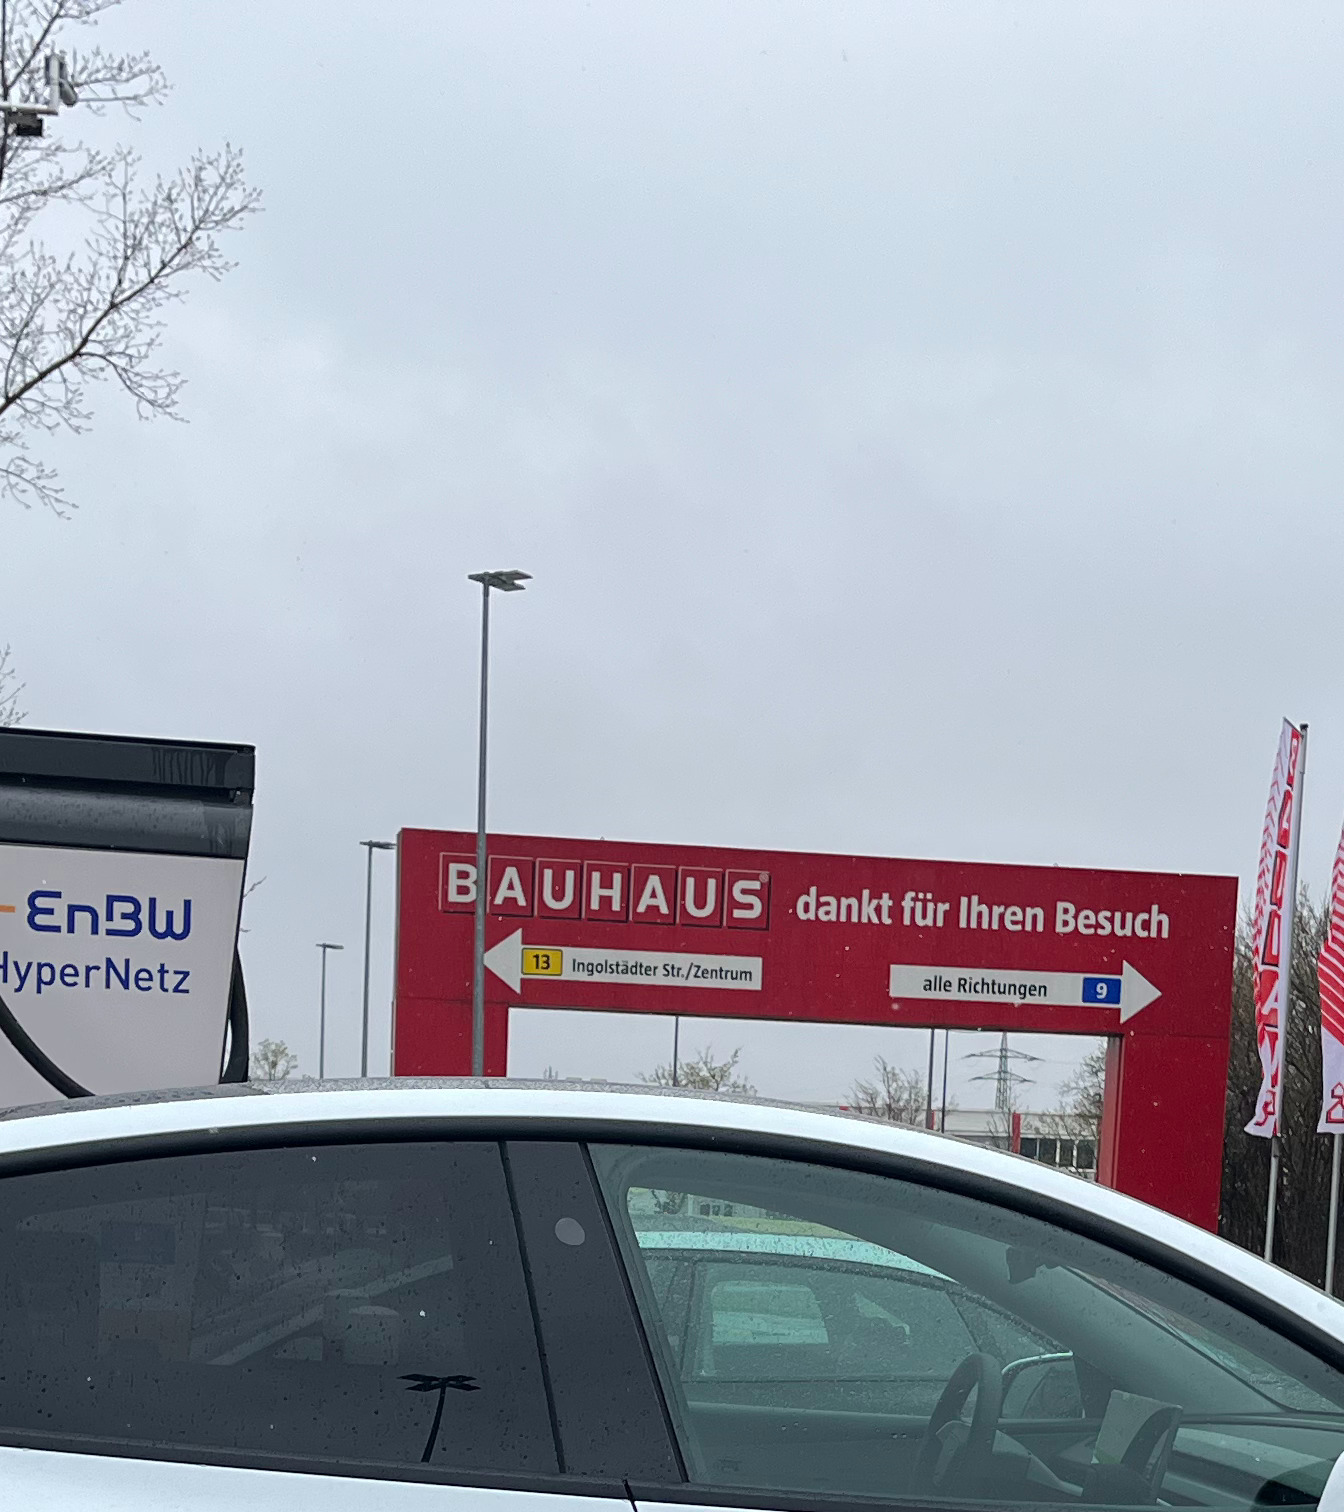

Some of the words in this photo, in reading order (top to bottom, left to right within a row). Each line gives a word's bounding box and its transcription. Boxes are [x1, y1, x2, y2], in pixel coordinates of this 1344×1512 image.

[27, 890, 192, 941] EnBW
[447, 862, 763, 919] BAUHAUS
[796, 886, 893, 925] dankt
[902, 891, 950, 927] für
[959, 895, 1045, 932] Ihren
[1056, 900, 1169, 939] Besuch
[533, 953, 551, 971] 13
[572, 958, 659, 978] Ingolstädter
[923, 975, 952, 992] alle
[957, 977, 1048, 1000] Richtungen
[1095, 982, 1108, 999] 9
